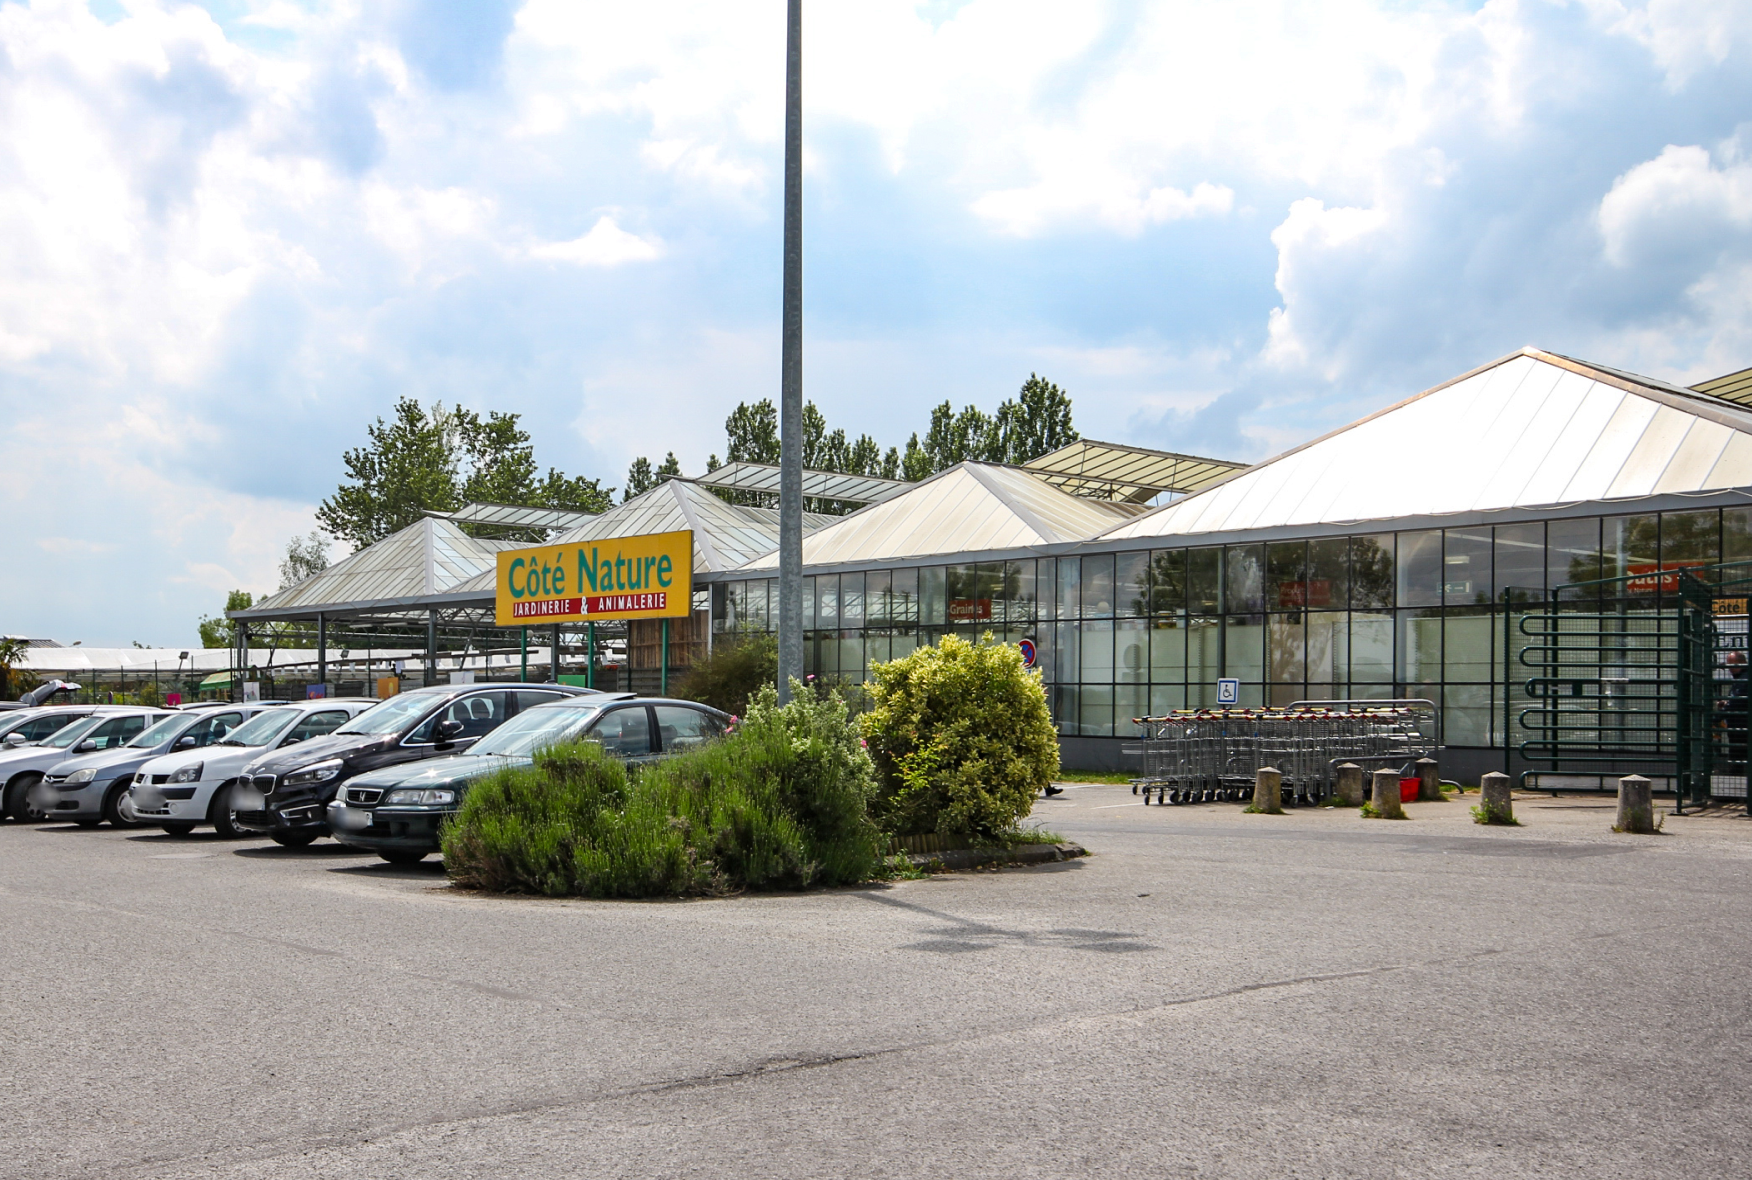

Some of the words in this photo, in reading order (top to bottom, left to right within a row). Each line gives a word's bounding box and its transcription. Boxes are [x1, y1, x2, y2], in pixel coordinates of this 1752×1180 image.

[508, 552, 565, 598] Côté
[577, 547, 673, 594] Nature
[514, 599, 570, 617] JARDINERIE
[580, 595, 589, 615] &
[598, 593, 665, 611] ANIMALERIE
[950, 603, 983, 615] Grains
